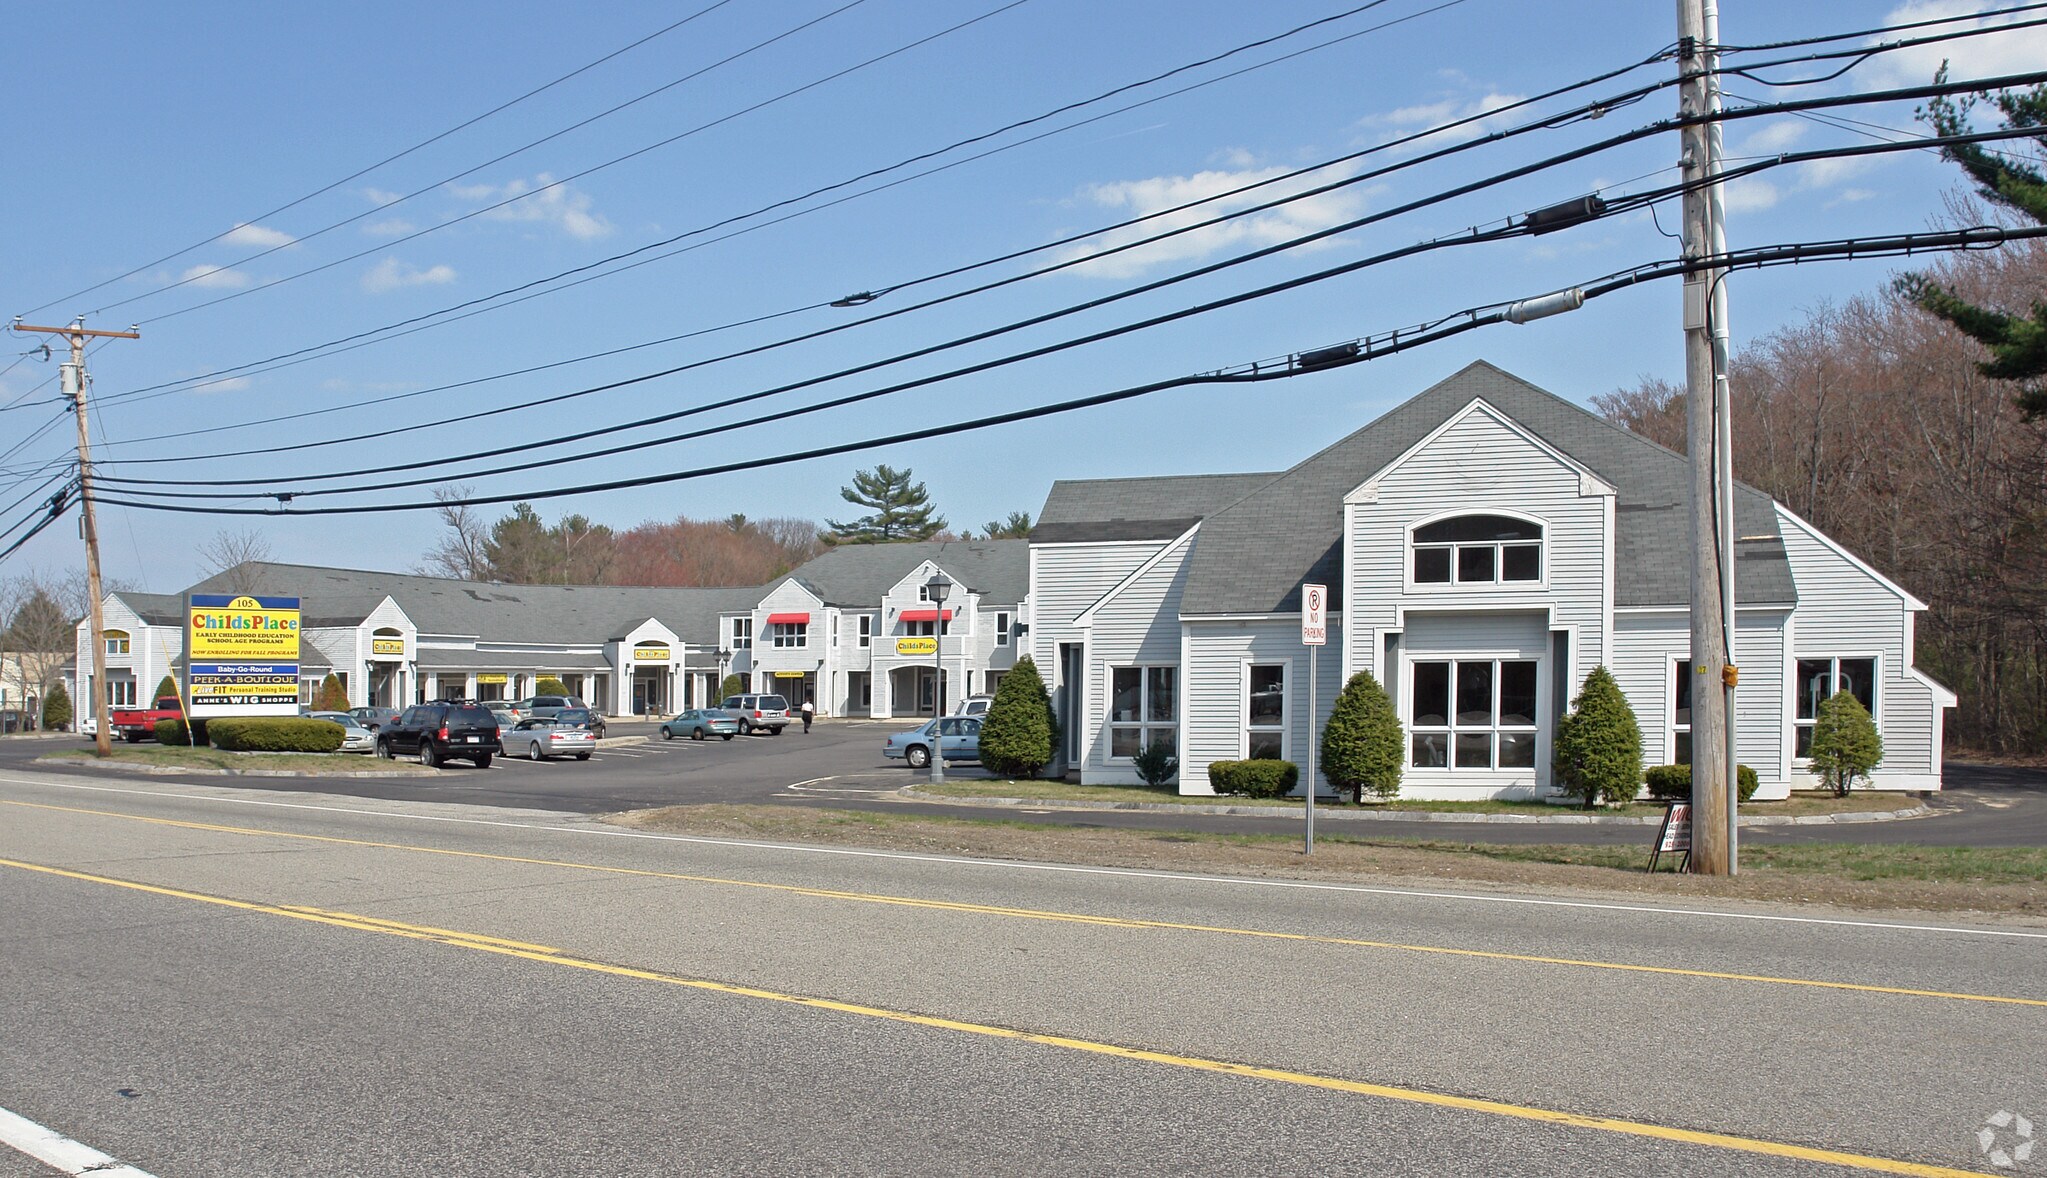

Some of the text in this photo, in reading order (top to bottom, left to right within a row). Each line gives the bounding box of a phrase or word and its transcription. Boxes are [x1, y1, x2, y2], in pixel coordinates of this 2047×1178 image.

[237, 599, 254, 608] 105
[192, 613, 298, 630] ChildsPlace
[1310, 612, 1319, 624] NO
[1304, 627, 1325, 639] PARKING
[217, 665, 273, 674] Baby-Go-Round
[194, 676, 295, 684] PEEK-A-BOUTIQUE
[255, 686, 278, 694] Training
[229, 695, 260, 704] WIG
